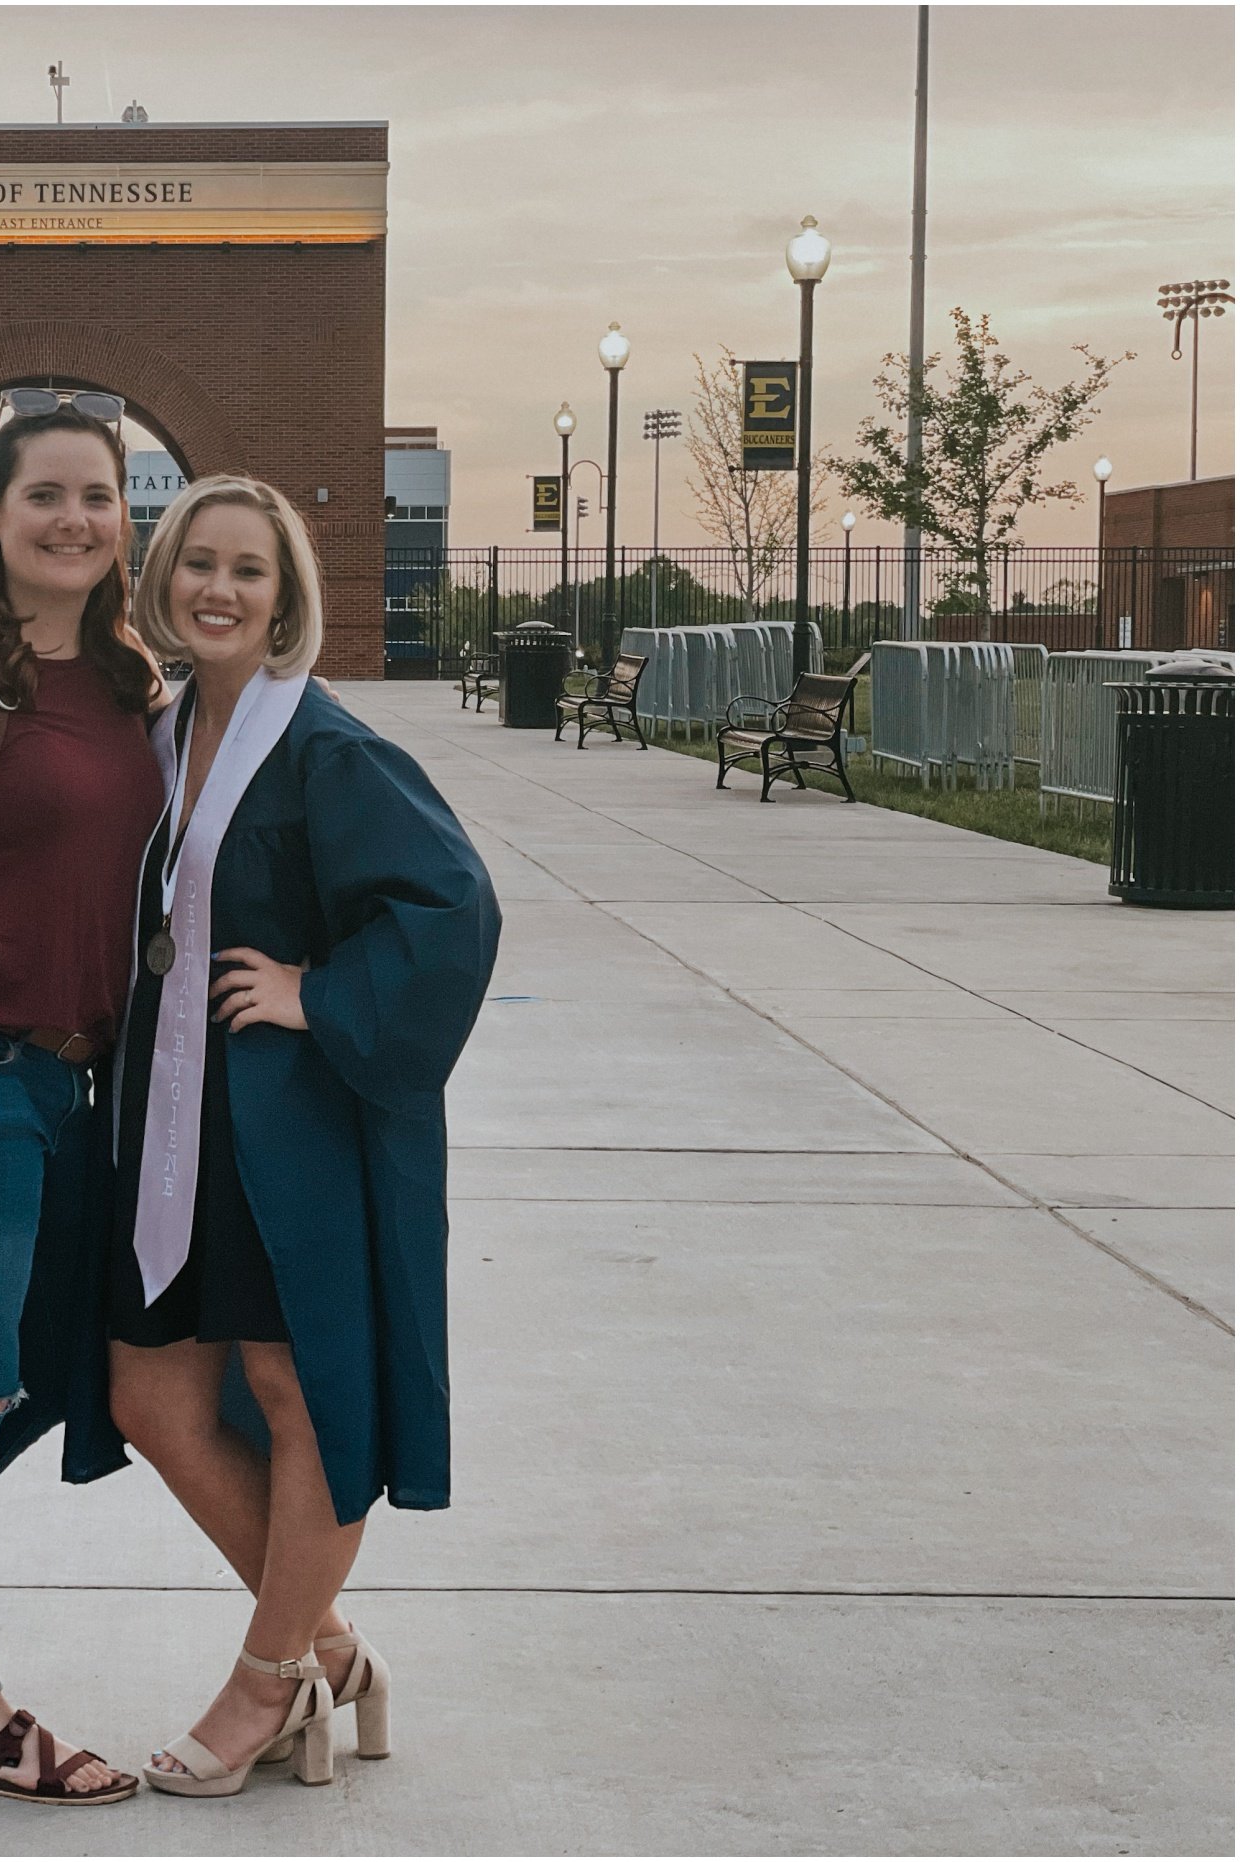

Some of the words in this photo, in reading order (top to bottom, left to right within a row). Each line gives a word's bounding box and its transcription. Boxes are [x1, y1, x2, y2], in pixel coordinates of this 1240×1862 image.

[34, 182, 193, 203] TENNESSEE
[31, 217, 104, 230] ENTRANCE
[748, 377, 791, 419] E
[743, 434, 795, 445] BUCCANEERS
[129, 475, 187, 490] TATE
[536, 483, 558, 506] E
[177, 879, 198, 1019] DENTAL
[161, 1033, 186, 1198] HYGIENE
